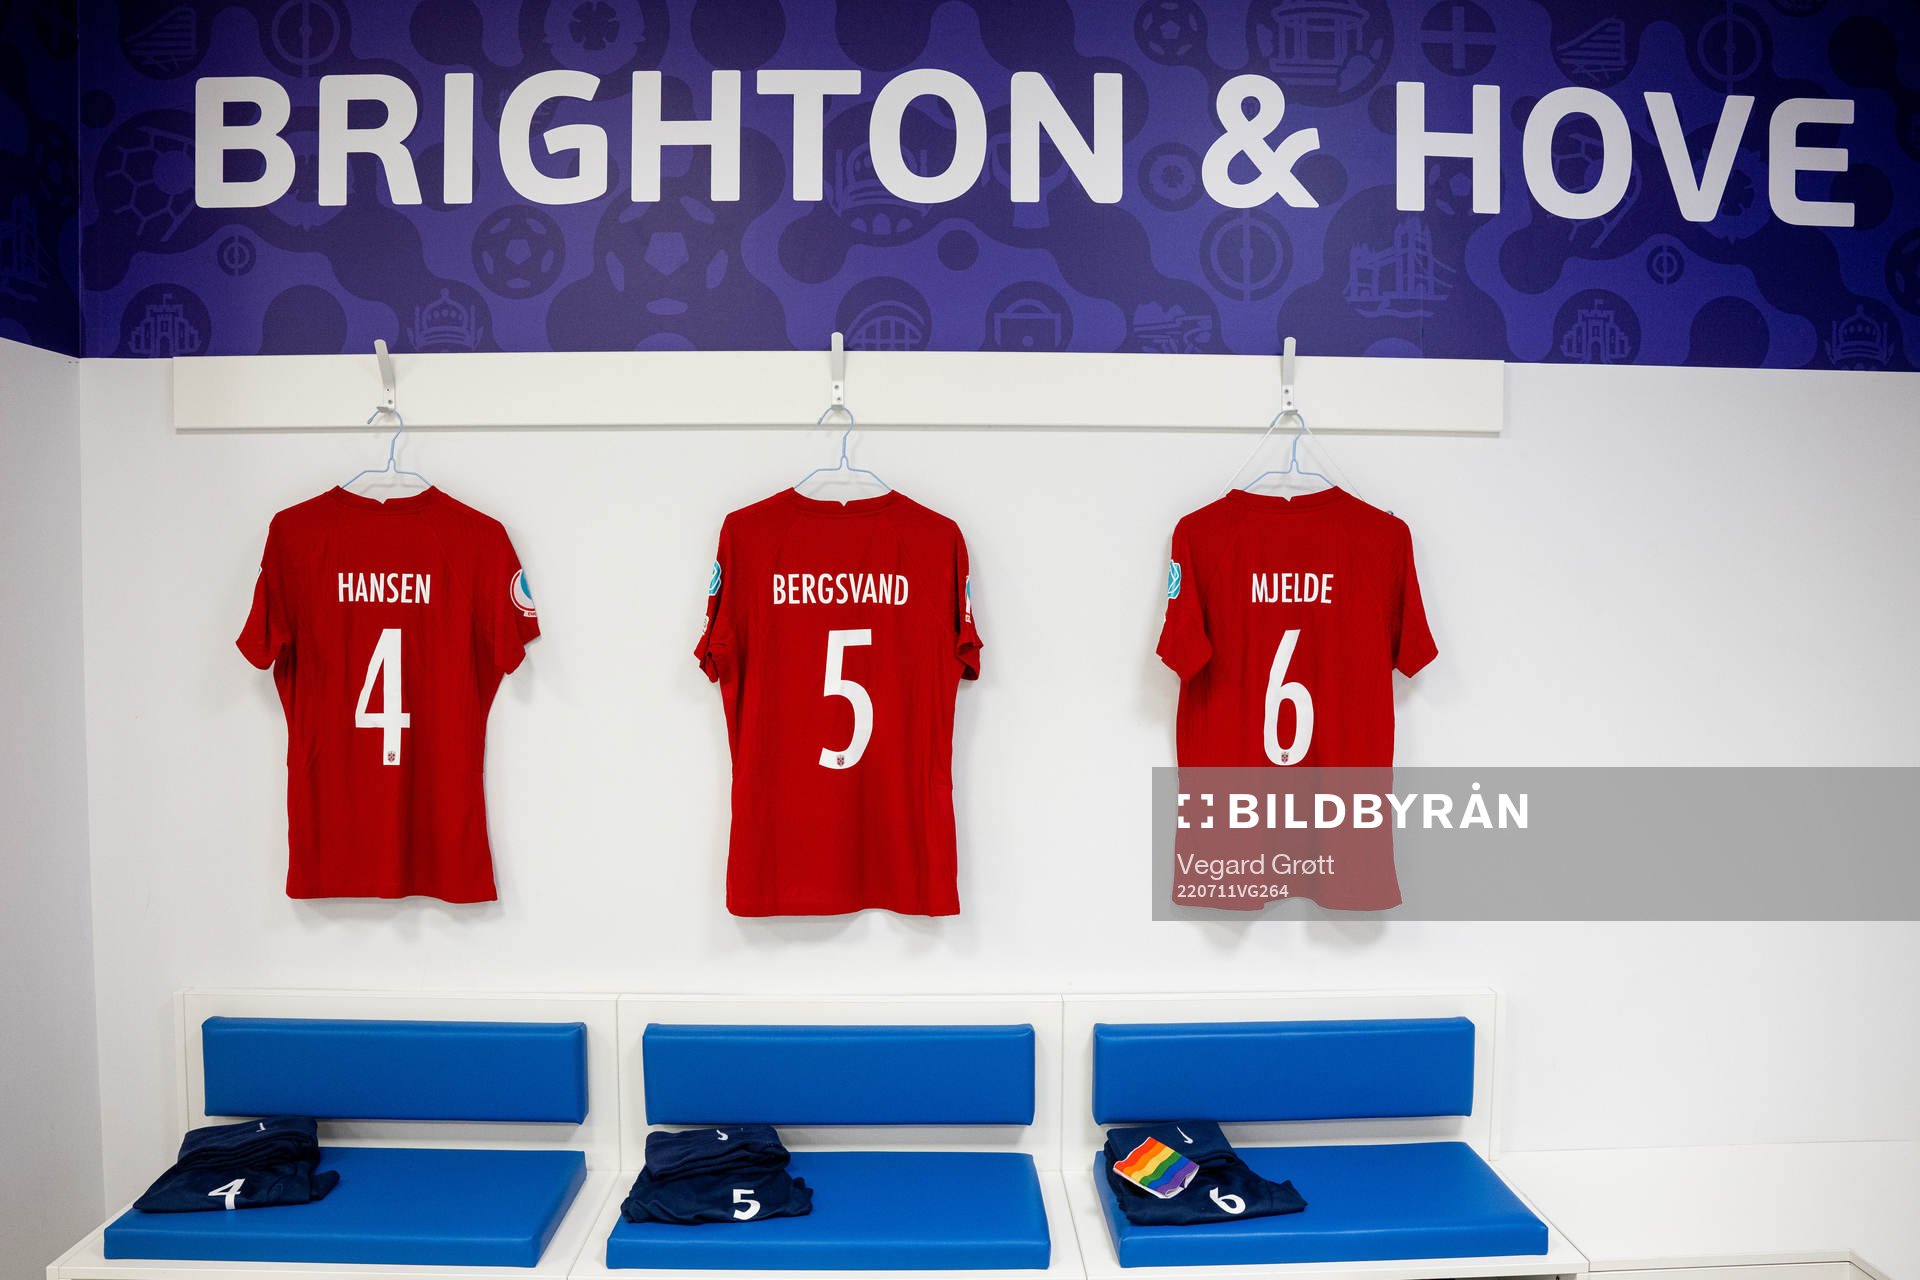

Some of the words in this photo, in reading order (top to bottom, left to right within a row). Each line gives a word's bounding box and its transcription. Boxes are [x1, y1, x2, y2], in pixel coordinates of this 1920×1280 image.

[196, 69, 1123, 208] BRIGHTON
[1201, 74, 1321, 208] &
[1396, 81, 1855, 227] HOVE
[337, 572, 431, 604] HANSEN
[773, 573, 909, 606] BERGSVAND
[1251, 572, 1334, 604] MJELDE
[355, 628, 411, 766] 4
[818, 628, 874, 770] 5
[1263, 629, 1315, 766] 6
[207, 1178, 246, 1210] 4
[732, 1188, 761, 1221] 5
[1209, 1186, 1246, 1215] 6
